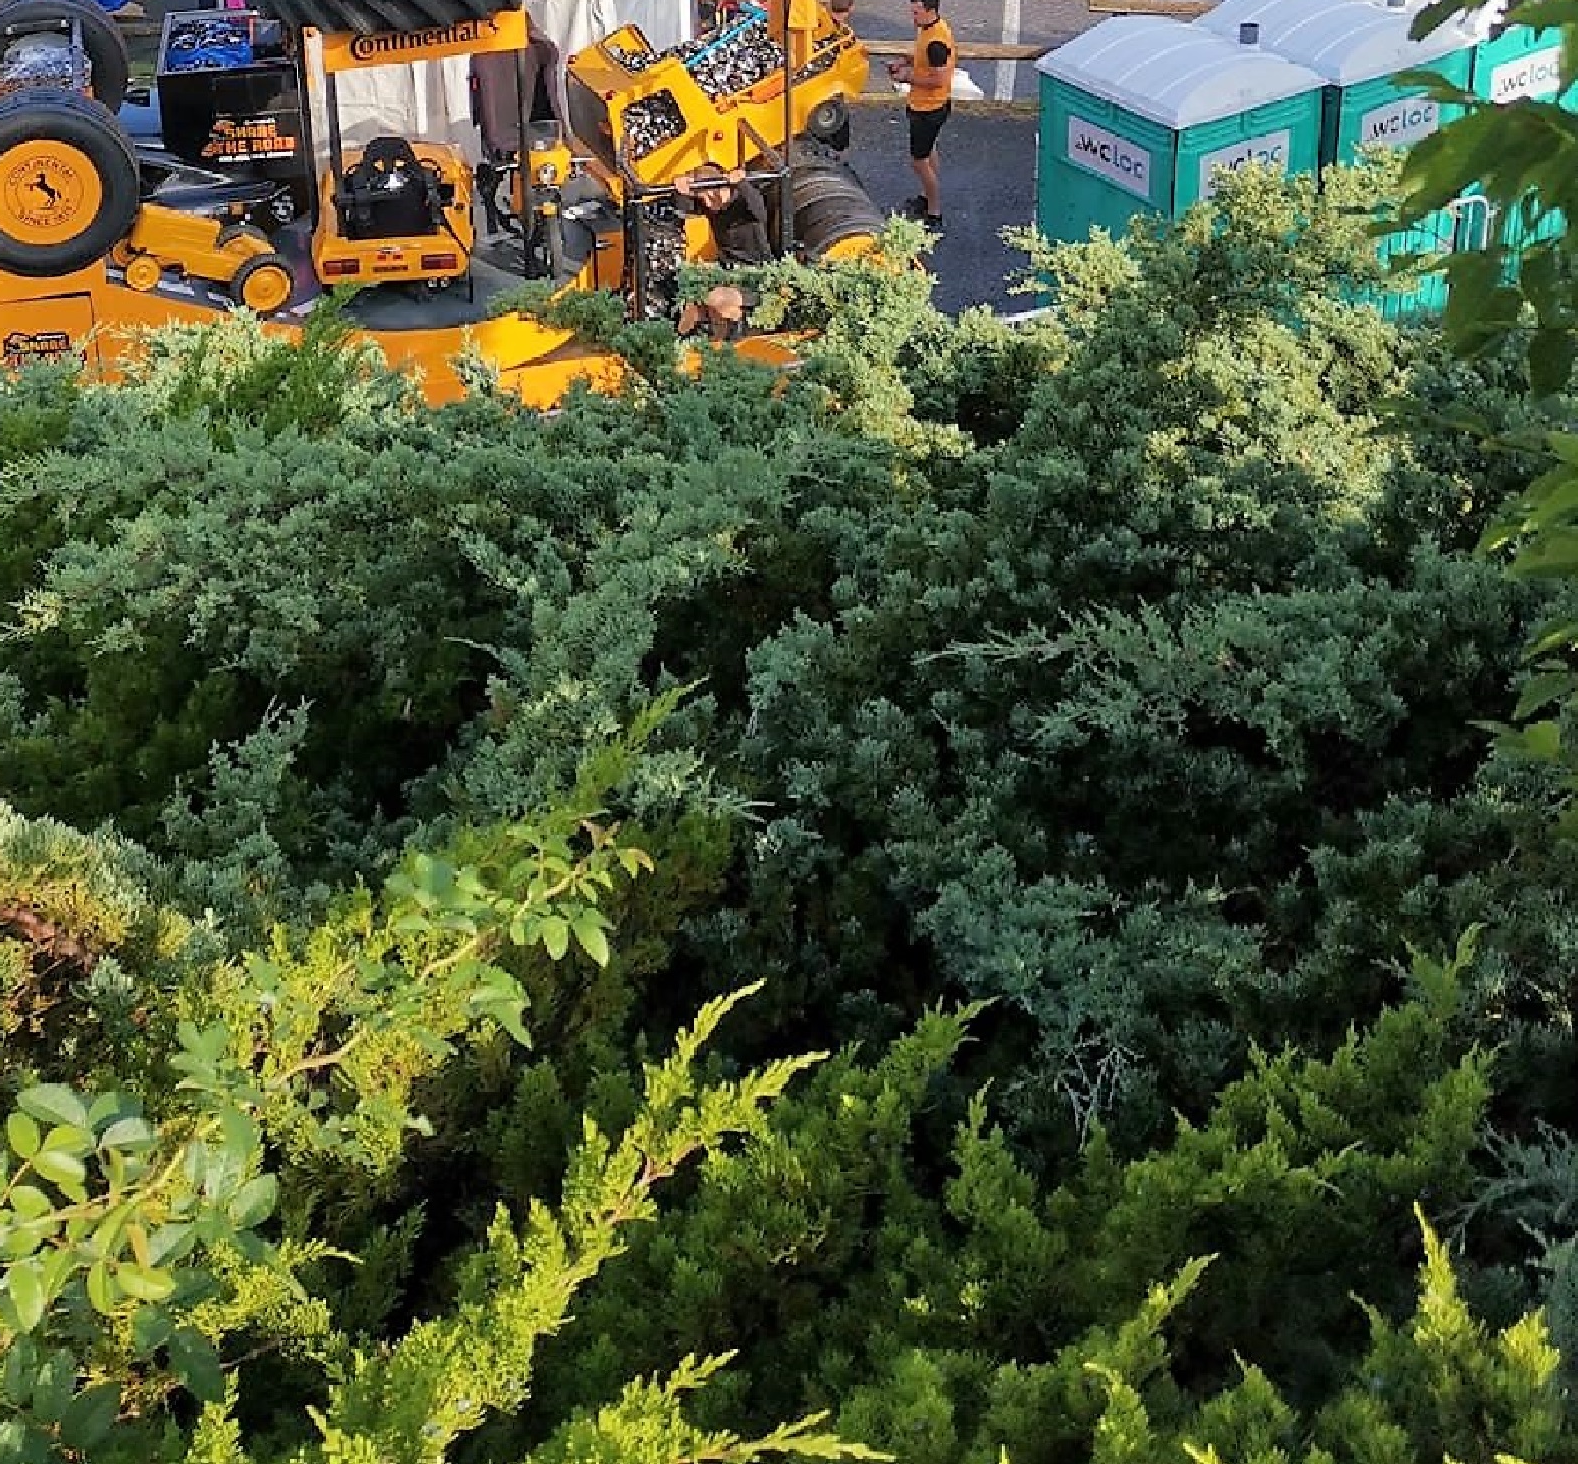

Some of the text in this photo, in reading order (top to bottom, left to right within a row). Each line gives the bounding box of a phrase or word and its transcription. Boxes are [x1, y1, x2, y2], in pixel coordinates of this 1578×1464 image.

[349, 18, 482, 61] Continental
[226, 124, 277, 138] SHARE
[252, 137, 295, 152] ROAD
